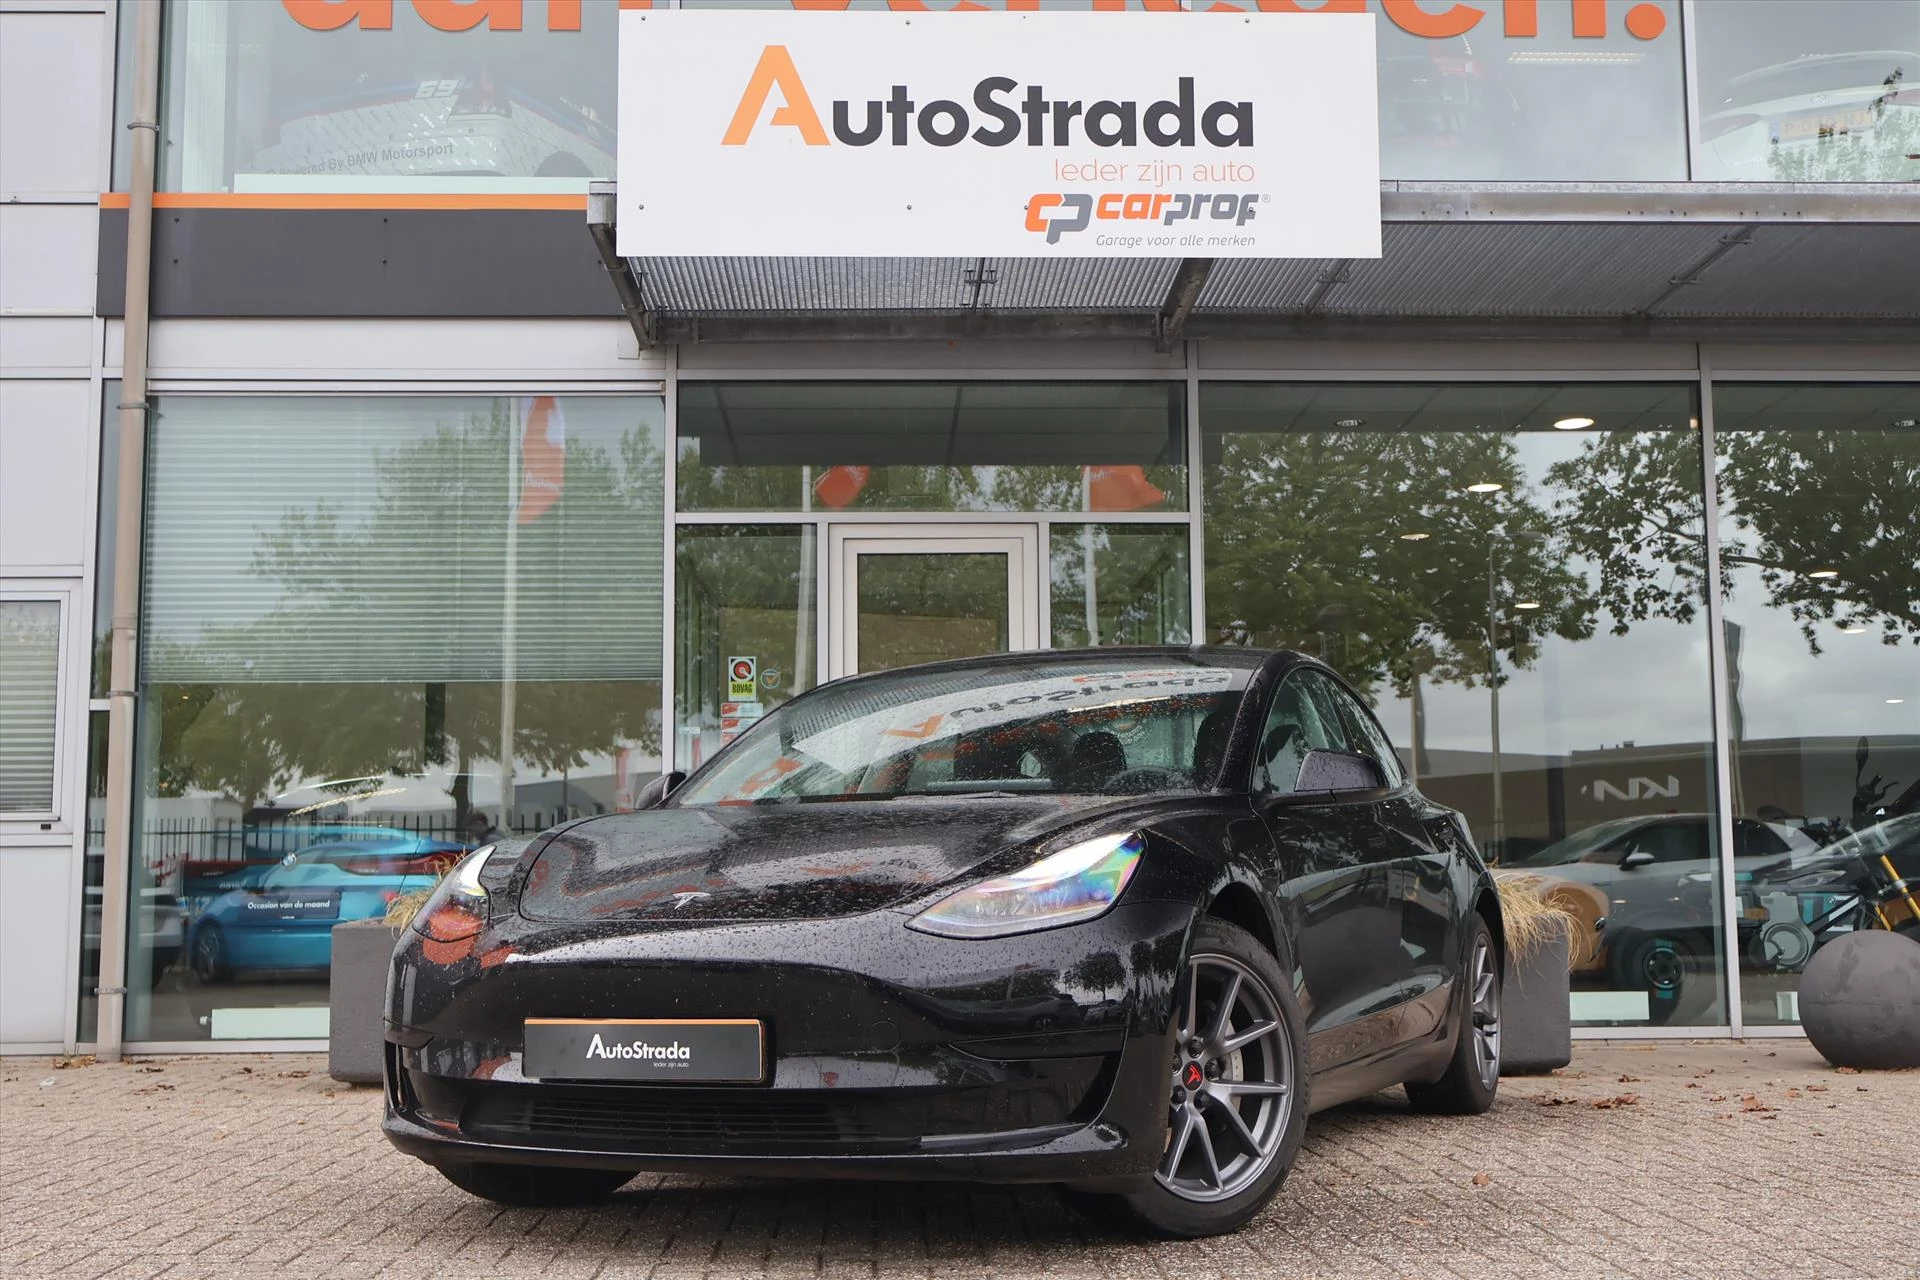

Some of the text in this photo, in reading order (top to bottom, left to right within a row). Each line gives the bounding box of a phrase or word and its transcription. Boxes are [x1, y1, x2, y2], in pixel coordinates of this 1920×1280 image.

[720, 45, 1254, 148] AutoStrada
[347, 152, 378, 167] BMW
[381, 143, 455, 161] Motorsport
[1055, 158, 1256, 188] Ieder zijn auto
[1095, 234, 1256, 249] Garage voor alle merken
[731, 683, 753, 695] BOVAG
[247, 899, 331, 911] Occasion van de maand
[586, 1033, 690, 1060] AutoStrada
